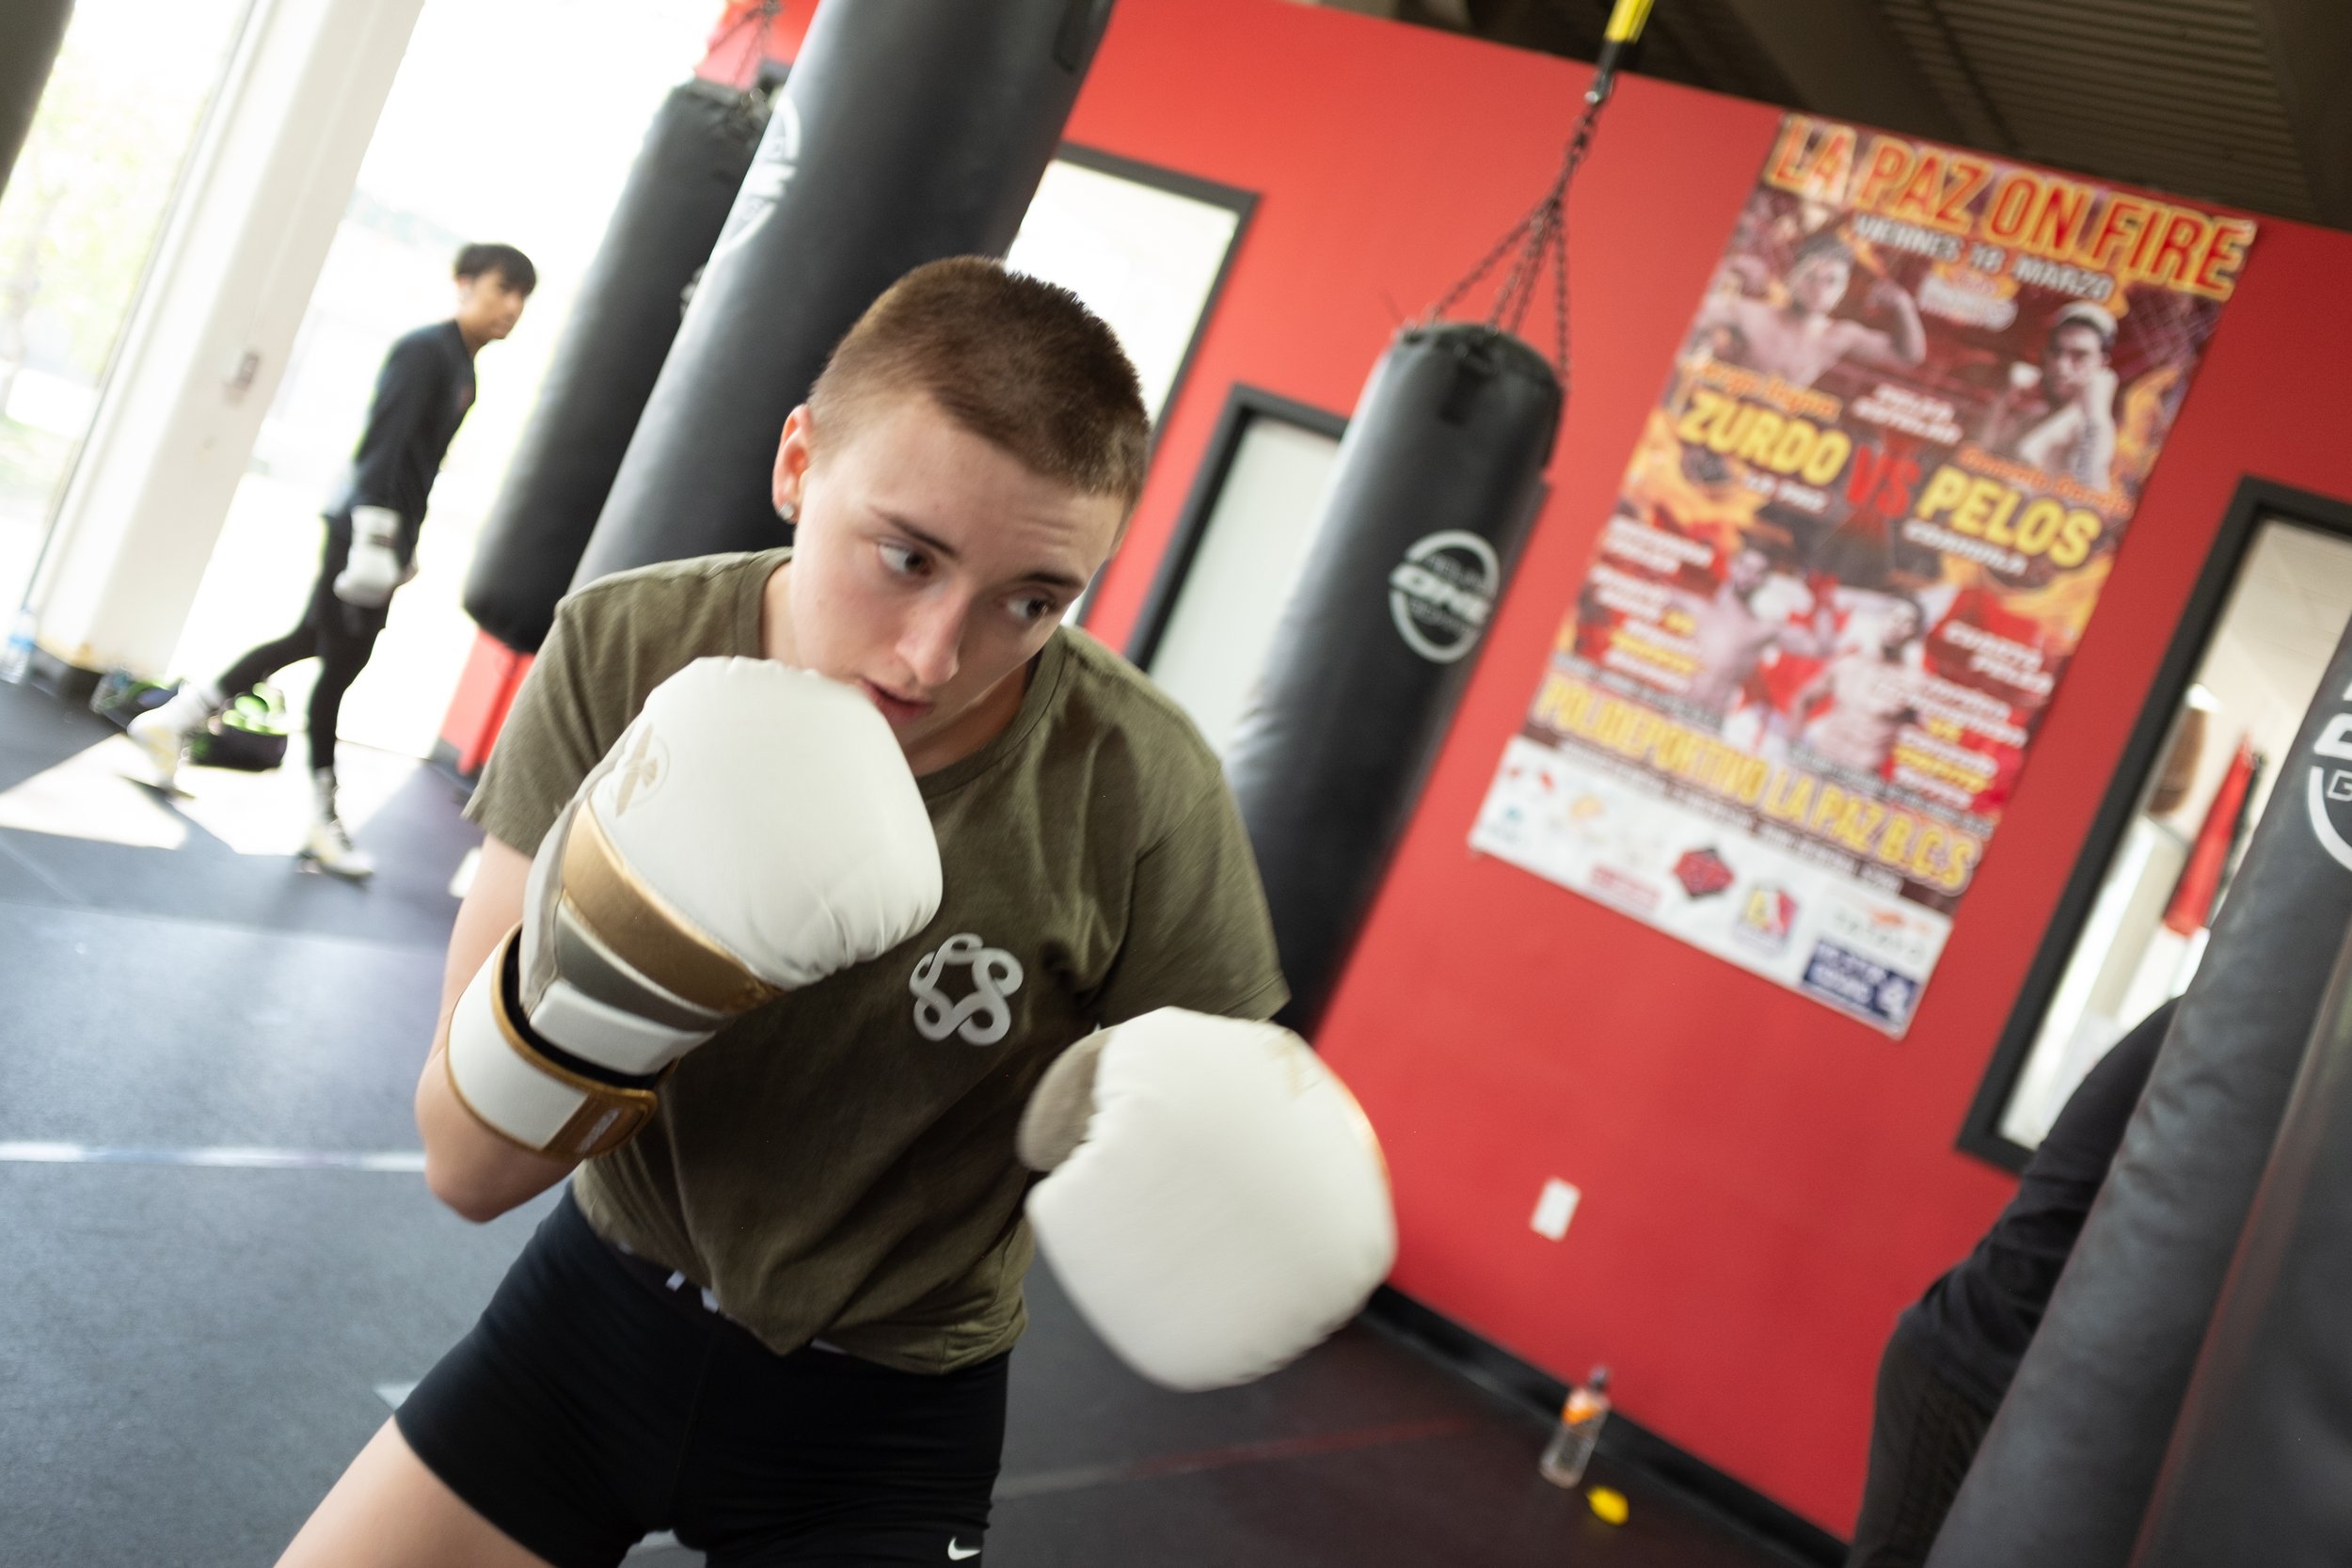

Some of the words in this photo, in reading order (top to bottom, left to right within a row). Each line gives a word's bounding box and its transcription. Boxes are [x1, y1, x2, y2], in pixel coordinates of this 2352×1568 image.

[1763, 114, 1856, 205] LA
[1853, 135, 1994, 233] PAZ
[1982, 168, 2094, 260] ON
[2082, 192, 2256, 301] FIRE
[1855, 213, 1963, 261] VIERNES
[2014, 255, 2114, 300] MARZO
[1677, 389, 1851, 485] ZURDO
[1846, 444, 1921, 516] VS
[1916, 465, 2103, 566] PELOS
[1764, 767, 1814, 821] LA
[1810, 782, 1886, 853] PAZ
